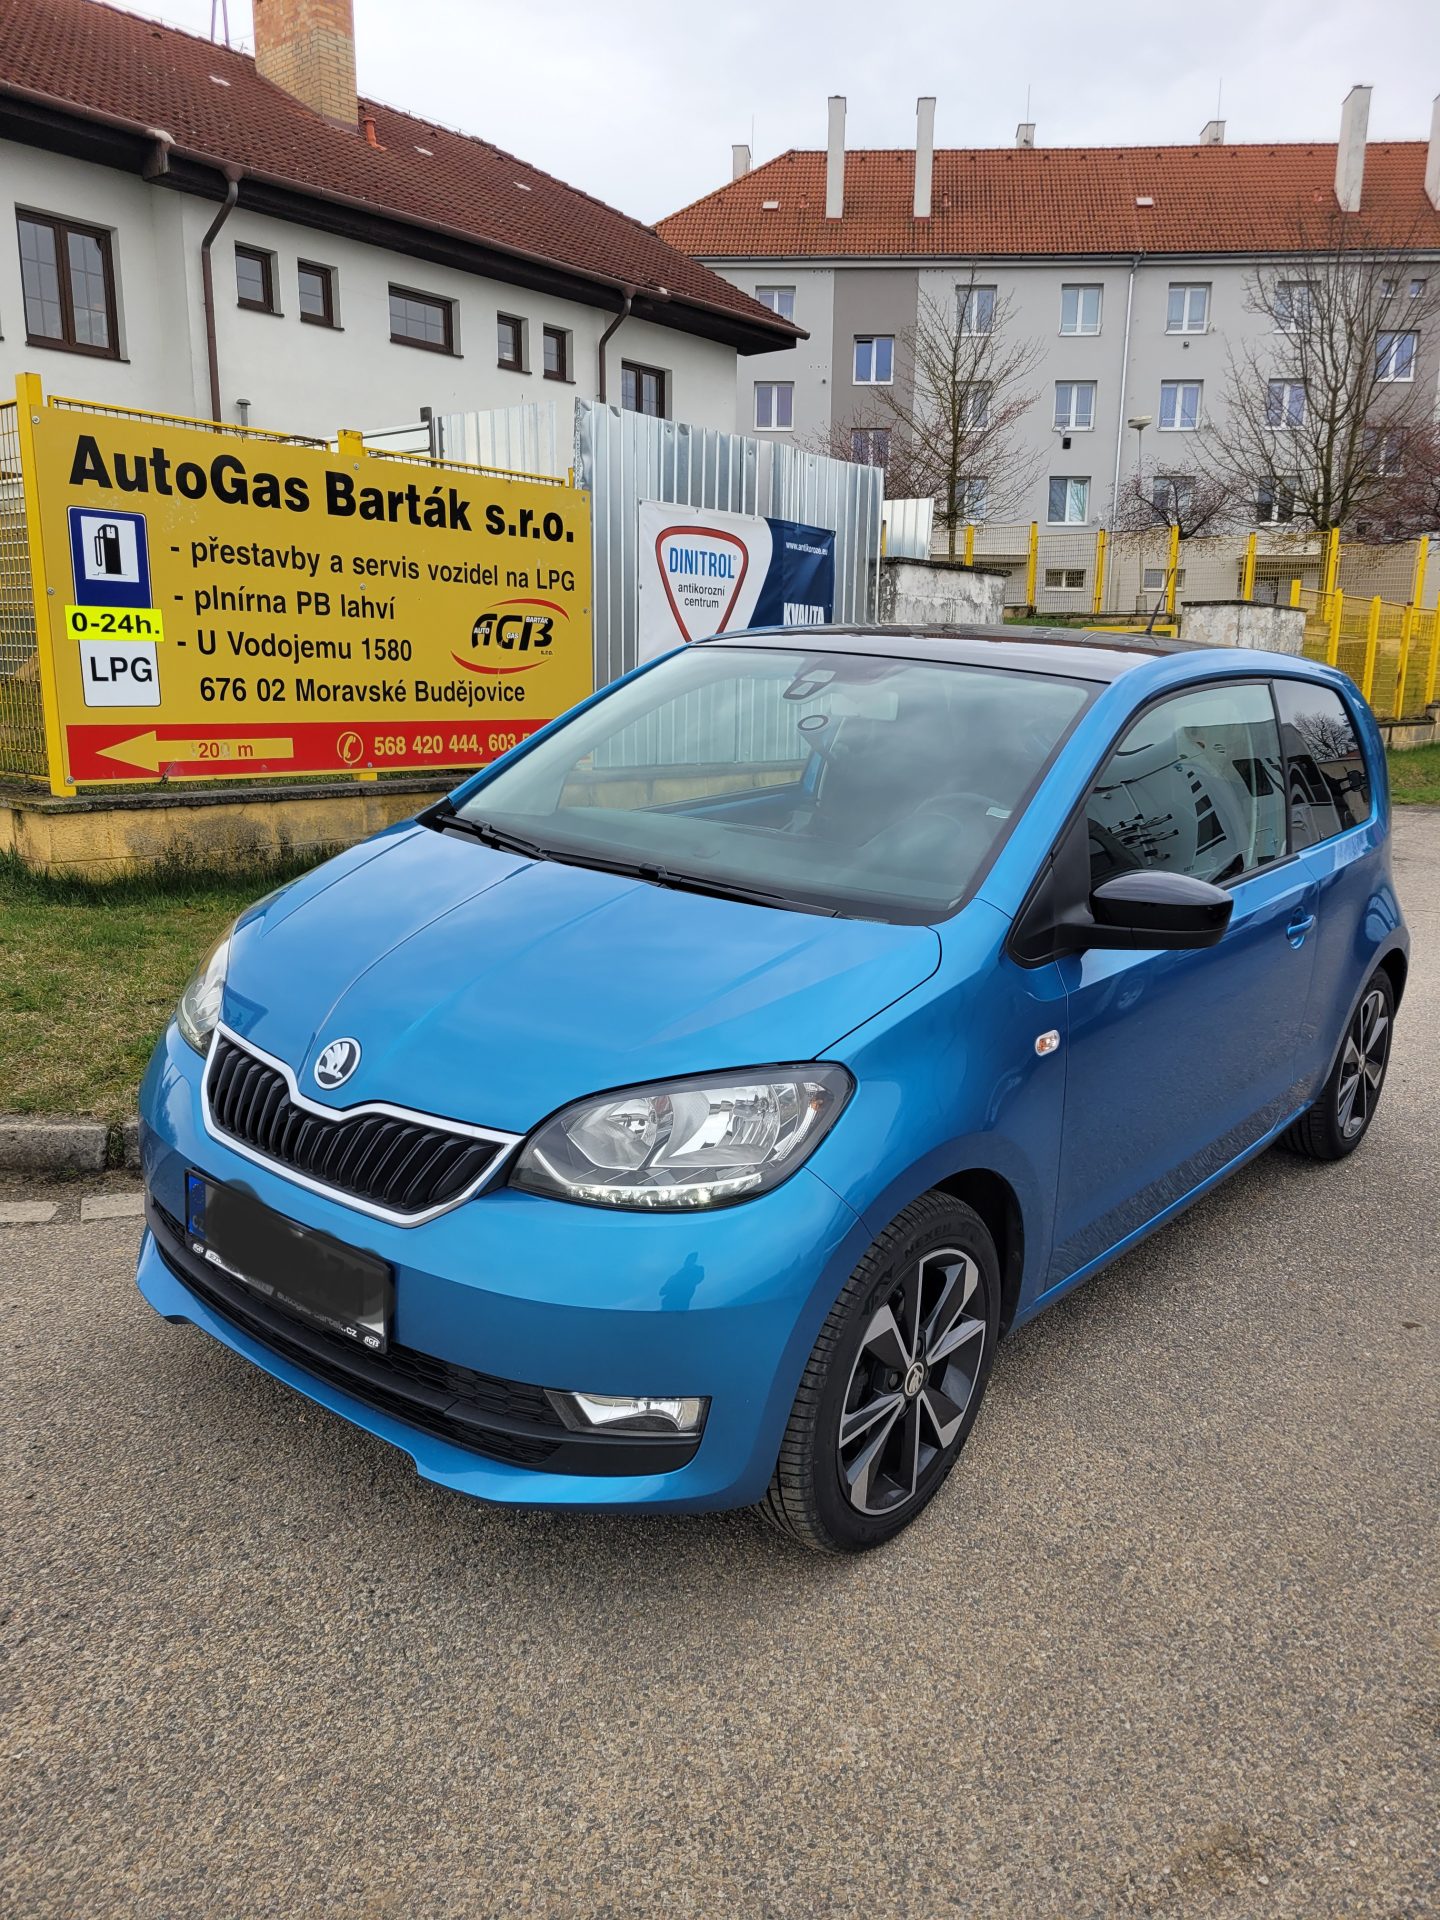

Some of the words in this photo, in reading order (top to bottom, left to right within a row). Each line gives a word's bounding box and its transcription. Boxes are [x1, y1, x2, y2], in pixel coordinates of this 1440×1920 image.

[69, 434, 310, 513] AutoGas
[325, 470, 472, 531] Barták
[485, 504, 574, 543] s.r.o.
[191, 536, 320, 577] přestavby
[330, 554, 343, 573] a
[352, 556, 420, 580] servis
[428, 562, 498, 586] vozidel
[506, 571, 529, 588] na
[537, 568, 575, 591] LPG
[669, 547, 735, 579] DINITROL
[195, 585, 286, 615] plnírna
[297, 590, 331, 616] PB
[340, 593, 396, 620] lahví
[678, 583, 726, 596] antikorozní
[684, 597, 719, 608] centrum
[71, 612, 160, 635] 0-24h.
[197, 630, 216, 655] U
[227, 631, 351, 665] Vodojemu
[362, 637, 412, 661] 1580
[90, 656, 153, 682] LPG
[200, 677, 247, 702] 676
[256, 678, 285, 702] 02
[296, 678, 406, 702] Moravské
[415, 680, 525, 707] Budějovice
[237, 744, 253, 757] m
[374, 737, 406, 756] 568
[412, 735, 443, 755] 420
[449, 734, 483, 755] 444,
[489, 733, 517, 751] 603
